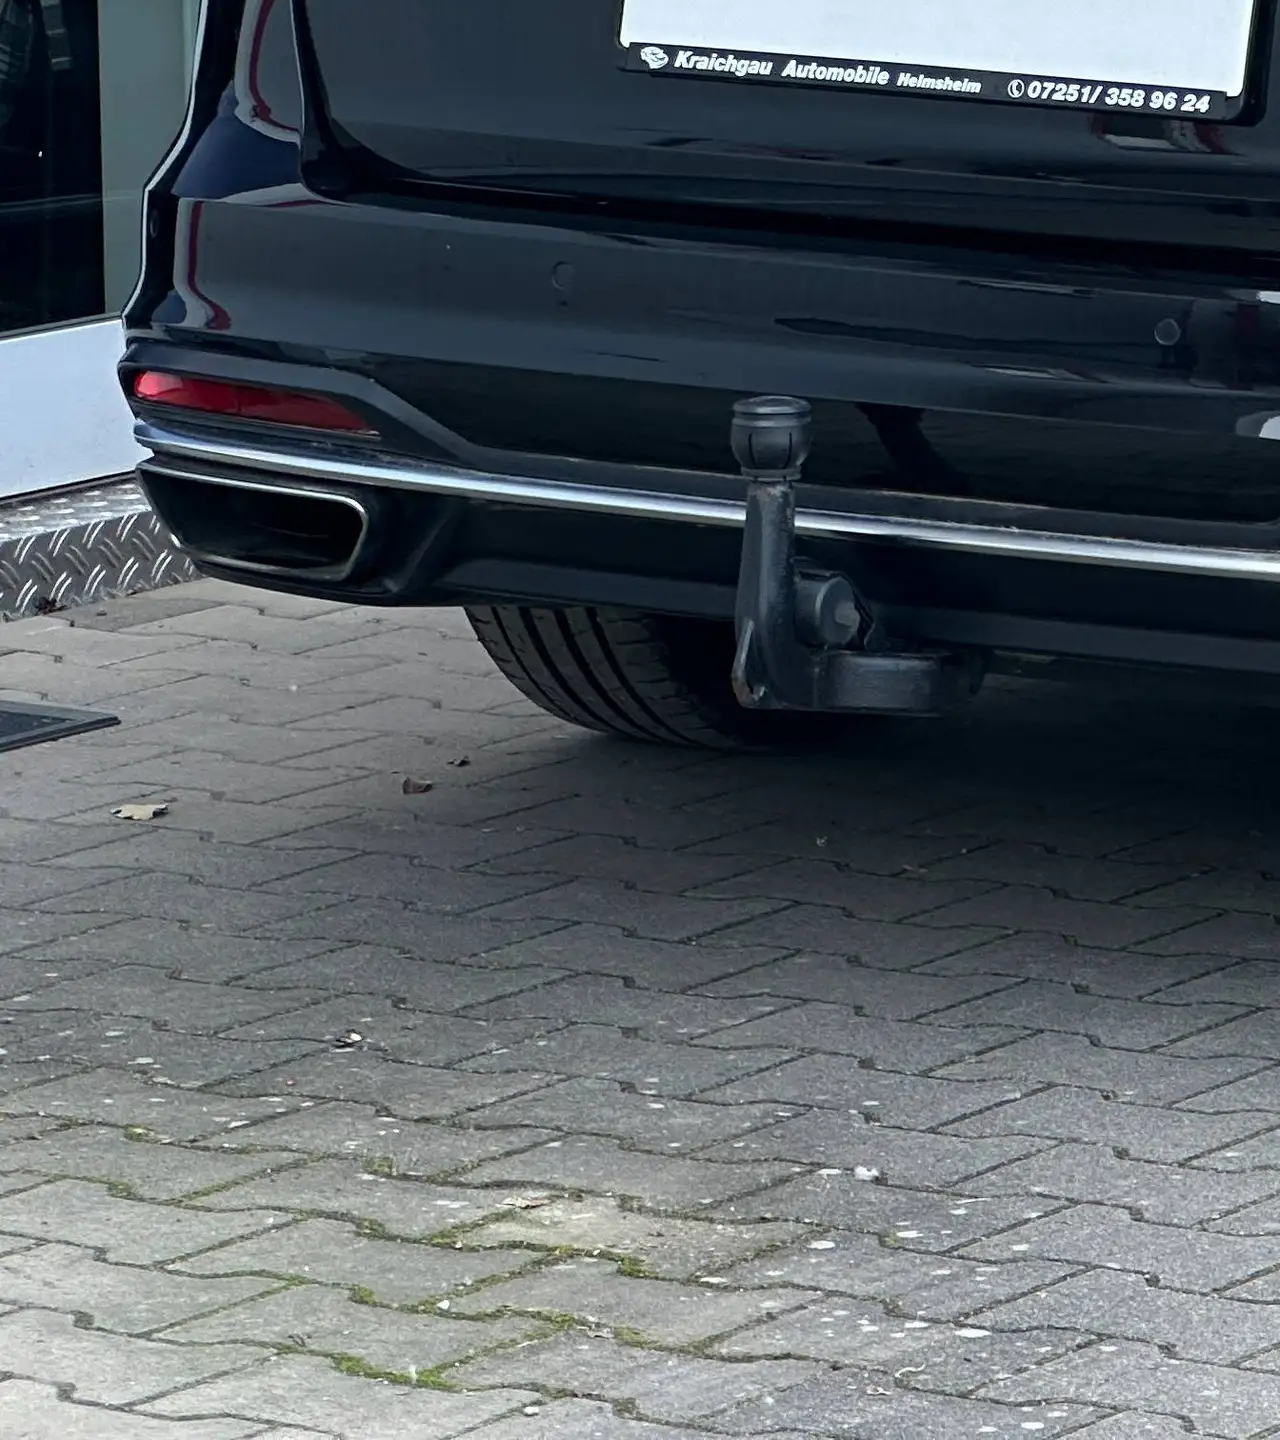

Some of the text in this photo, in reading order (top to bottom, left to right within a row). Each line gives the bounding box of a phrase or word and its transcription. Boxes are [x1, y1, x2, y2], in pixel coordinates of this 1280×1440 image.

[674, 50, 773, 76] Kraichgau
[781, 59, 890, 85] Automobile
[896, 72, 982, 94] Helmsheim
[1104, 87, 1146, 108] 358
[1149, 91, 1178, 111] 96
[1180, 93, 1211, 113] 24
